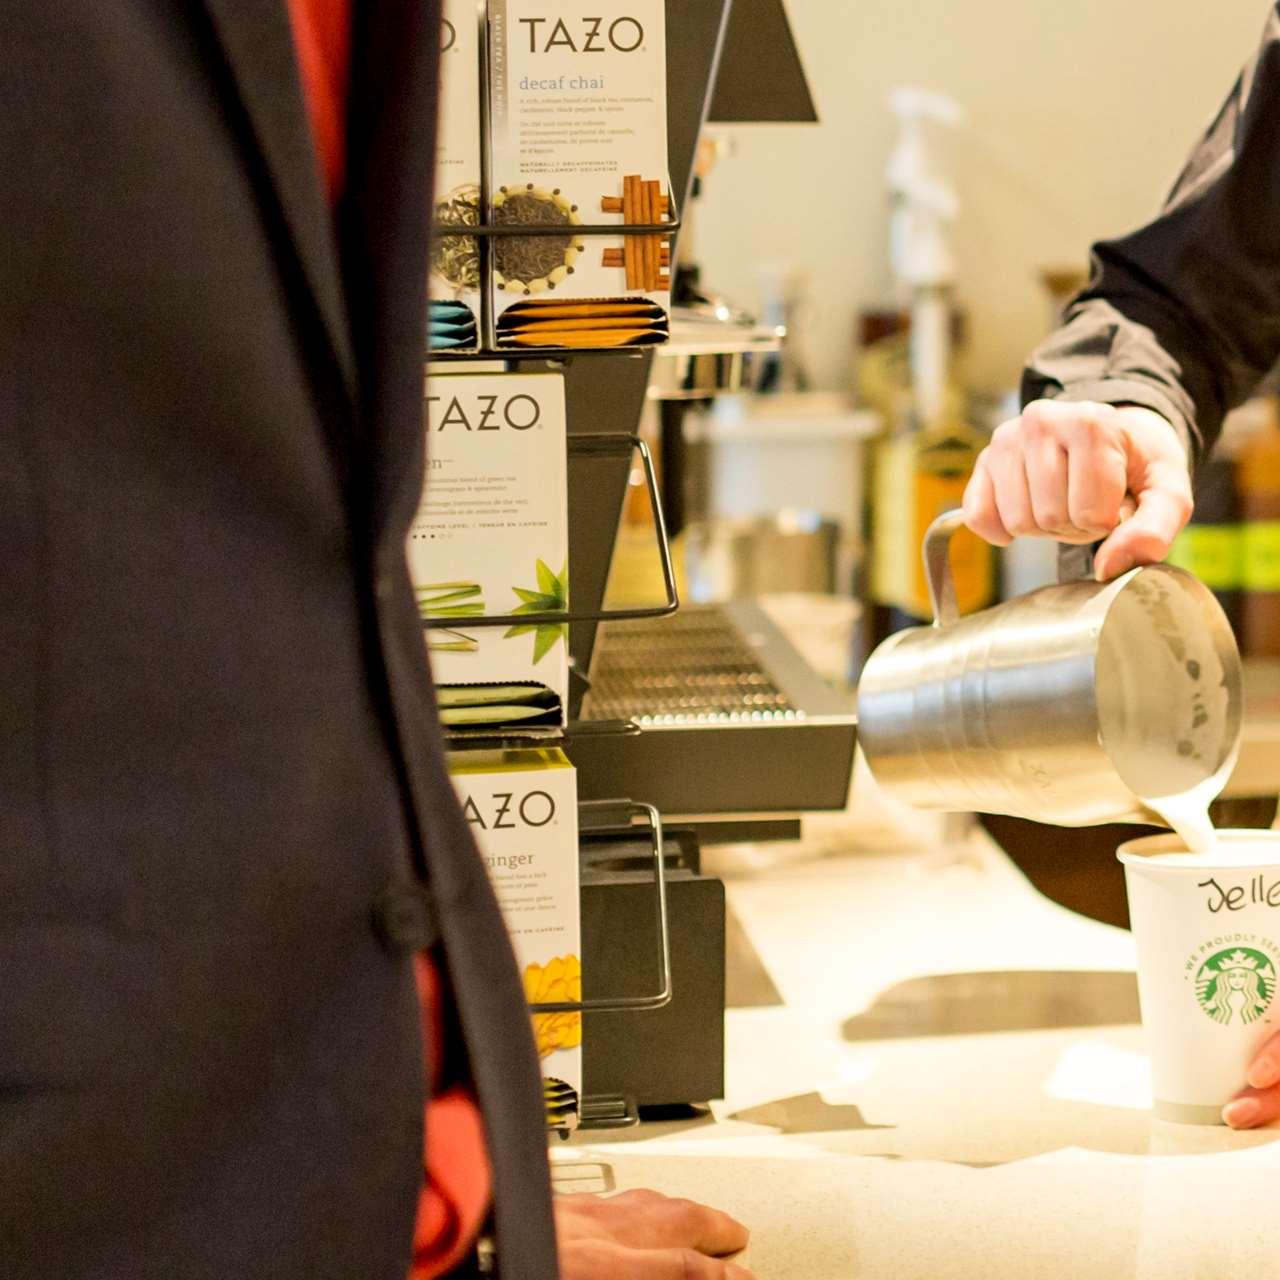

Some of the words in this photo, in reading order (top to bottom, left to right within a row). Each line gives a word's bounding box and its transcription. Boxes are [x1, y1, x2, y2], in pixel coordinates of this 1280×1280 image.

[519, 16, 644, 53] TAZO
[519, 76, 565, 90] decaf
[569, 75, 604, 89] chai
[1199, 933, 1256, 952] PROUDLY
